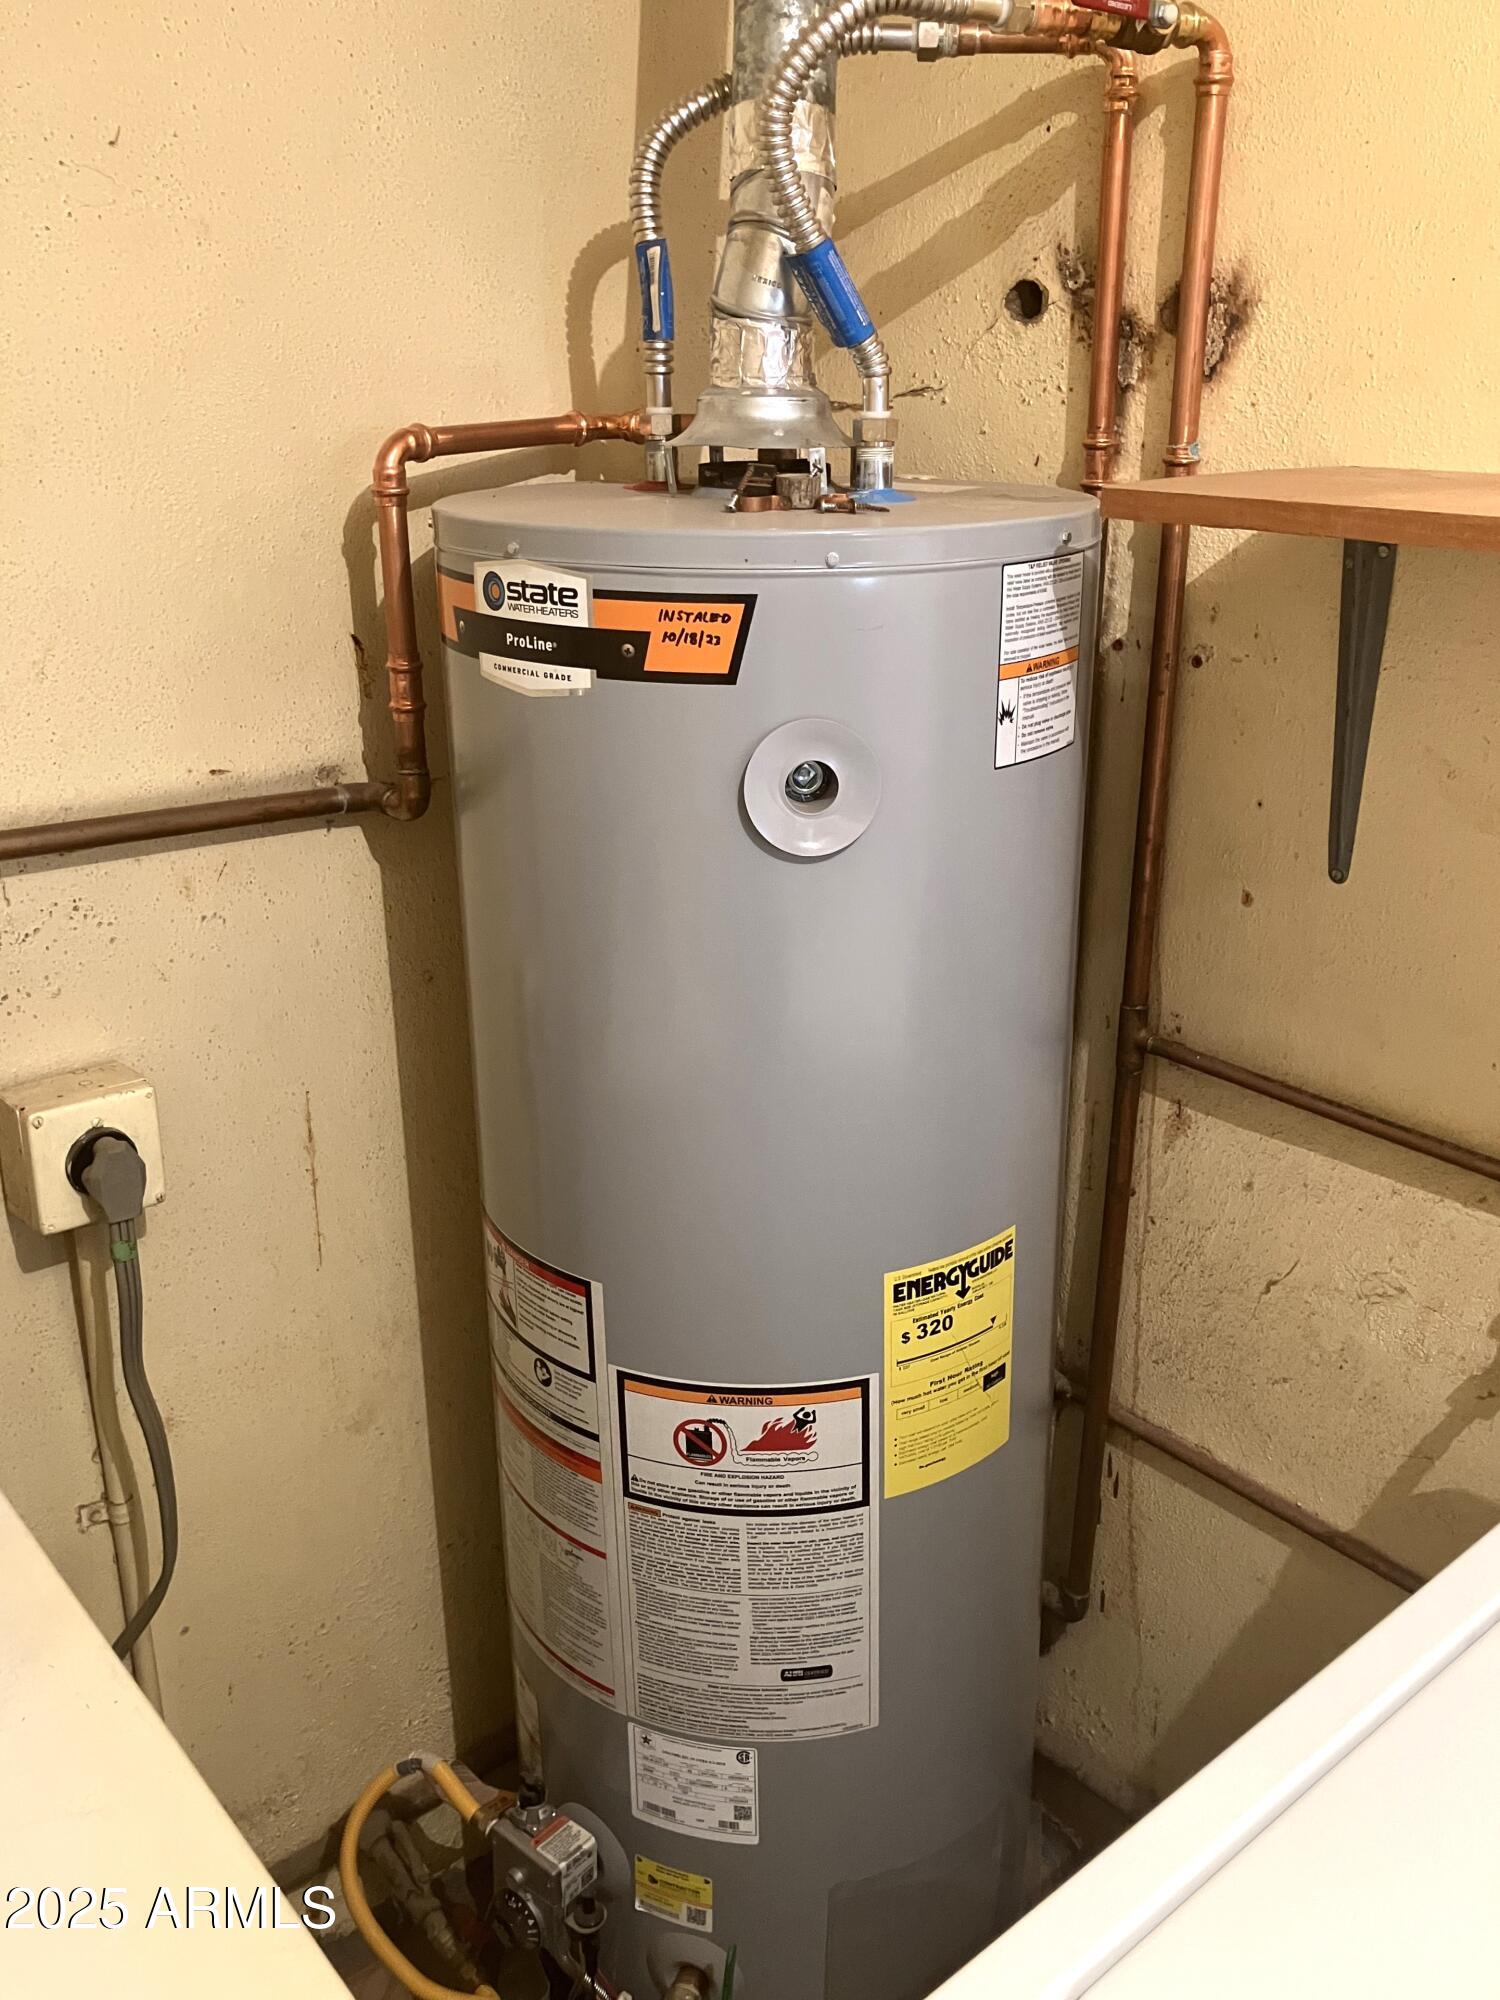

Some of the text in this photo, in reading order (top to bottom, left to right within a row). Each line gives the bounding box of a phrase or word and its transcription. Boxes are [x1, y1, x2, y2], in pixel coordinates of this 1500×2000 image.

[506, 580, 578, 608] state
[507, 602, 579, 619] WATER HEATERS
[493, 662, 573, 682] COMMERCIAL GRADE
[1032, 656, 1060, 671] WARNING
[893, 1238, 1014, 1304] ENERGYGUIDE
[912, 1312, 939, 1324] Estimated
[940, 1305, 956, 1315] Yearly
[957, 1298, 973, 1309] Energy
[974, 1293, 984, 1301] Cost
[901, 1314, 954, 1345] $ 320
[929, 1361, 984, 1387] First Hour Rating
[719, 1395, 774, 1405] WARNING
[907, 1392, 922, 1400] much
